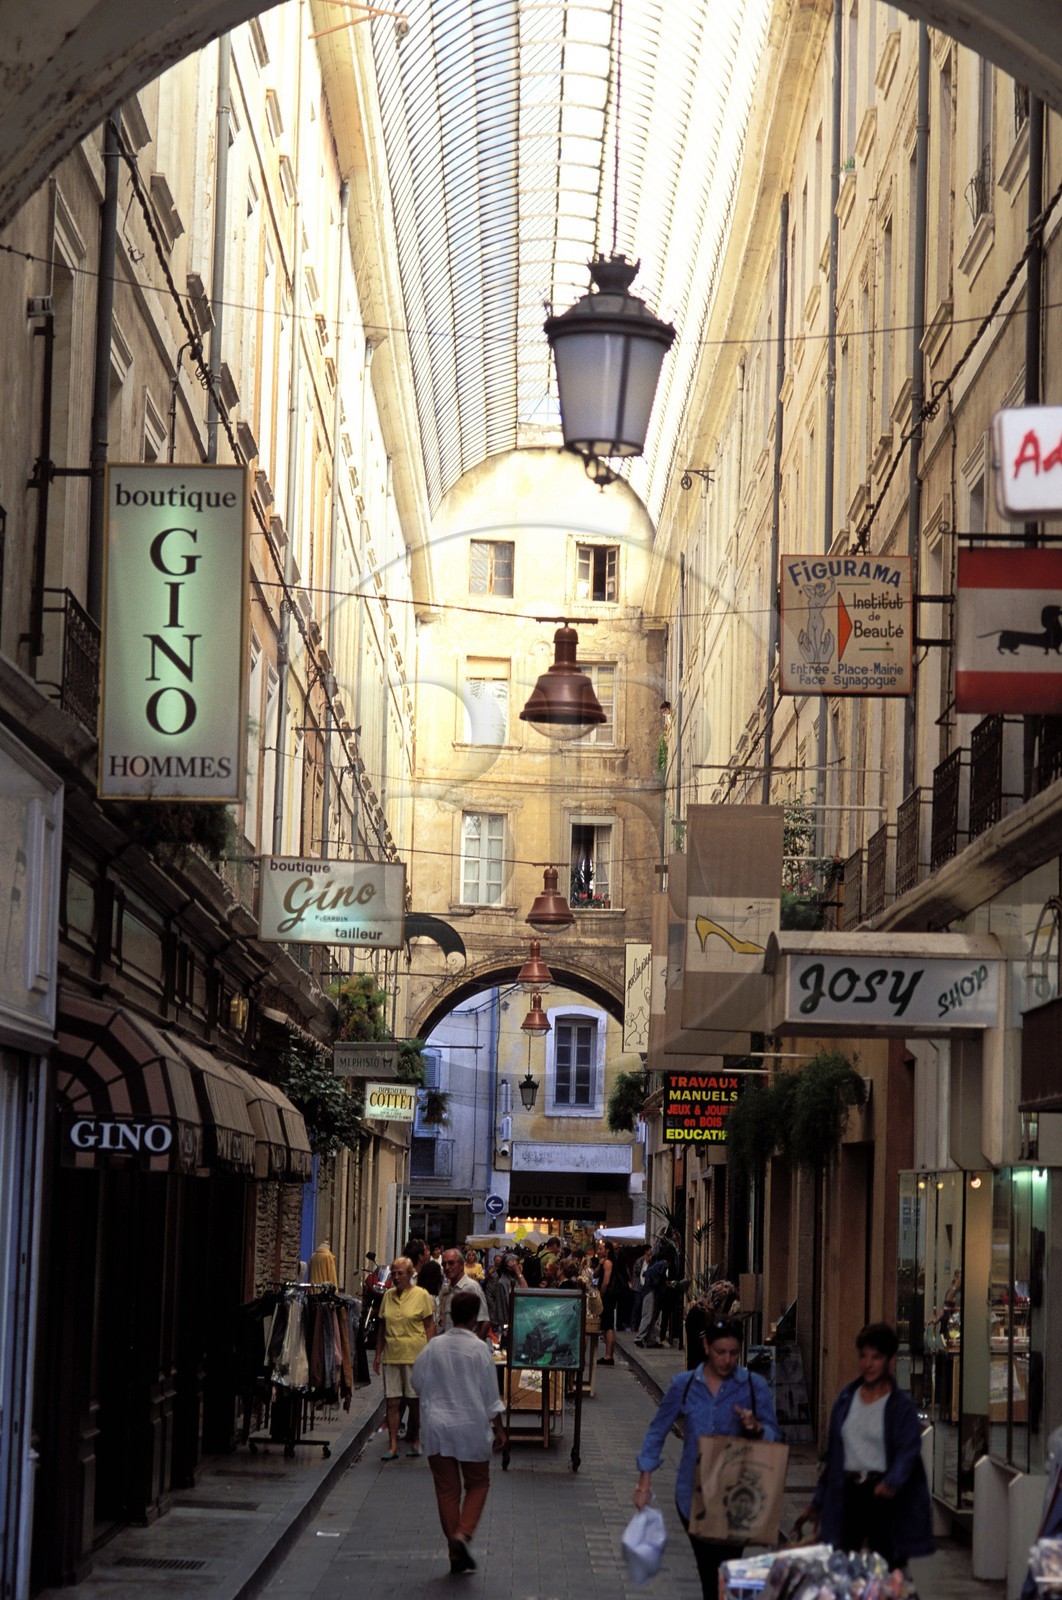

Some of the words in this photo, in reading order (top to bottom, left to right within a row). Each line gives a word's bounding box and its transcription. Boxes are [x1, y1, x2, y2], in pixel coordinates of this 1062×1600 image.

[115, 483, 237, 513] boutique
[853, 591, 904, 610] Institut
[868, 613, 881, 621] de
[143, 527, 203, 736] GINO
[853, 619, 905, 639] Beauté
[790, 664, 830, 675] Entrée
[799, 675, 826, 686] Face
[833, 675, 897, 690] Synagogue
[108, 754, 232, 780] HOMMES
[270, 859, 331, 877] boutique
[276, 876, 377, 934] Gino
[335, 927, 384, 941] tailleur
[799, 962, 925, 1018] JOSY
[937, 963, 989, 1019] SHOP
[669, 1076, 738, 1089] TRAVAUX
[369, 1091, 415, 1110] COTTET
[669, 1089, 738, 1102] MANUELS
[667, 1104, 691, 1115] JEUX
[694, 1104, 701, 1115] &
[683, 1118, 696, 1128] en
[699, 1117, 722, 1128] BOIS
[70, 1120, 172, 1152] GINO
[511, 1195, 591, 1209] JOUTERIE
